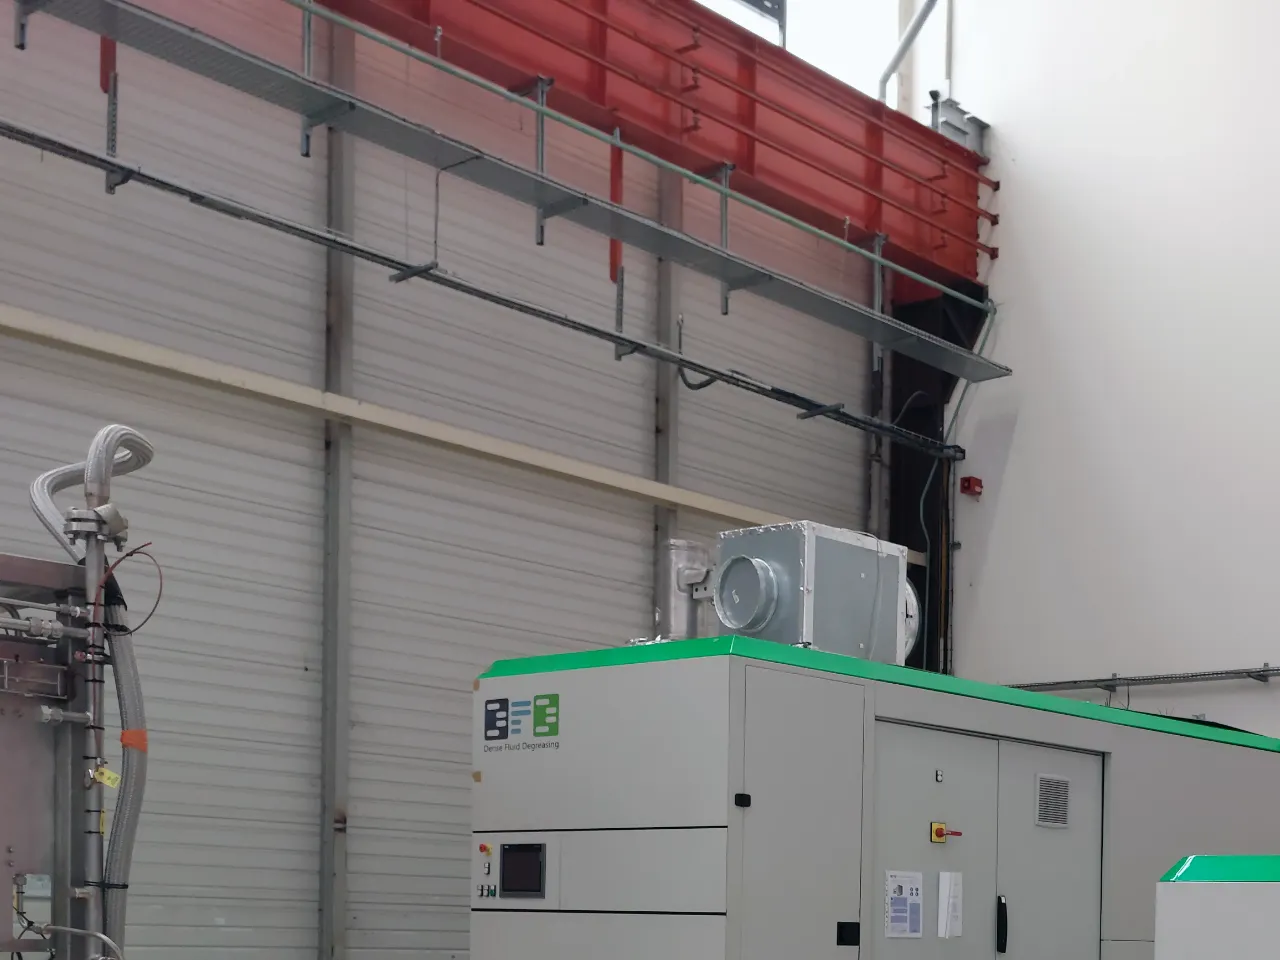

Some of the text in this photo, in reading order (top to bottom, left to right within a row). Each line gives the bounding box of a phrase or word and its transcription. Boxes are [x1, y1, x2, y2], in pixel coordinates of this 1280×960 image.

[483, 741, 560, 753] Dense Fluid Degreasing
